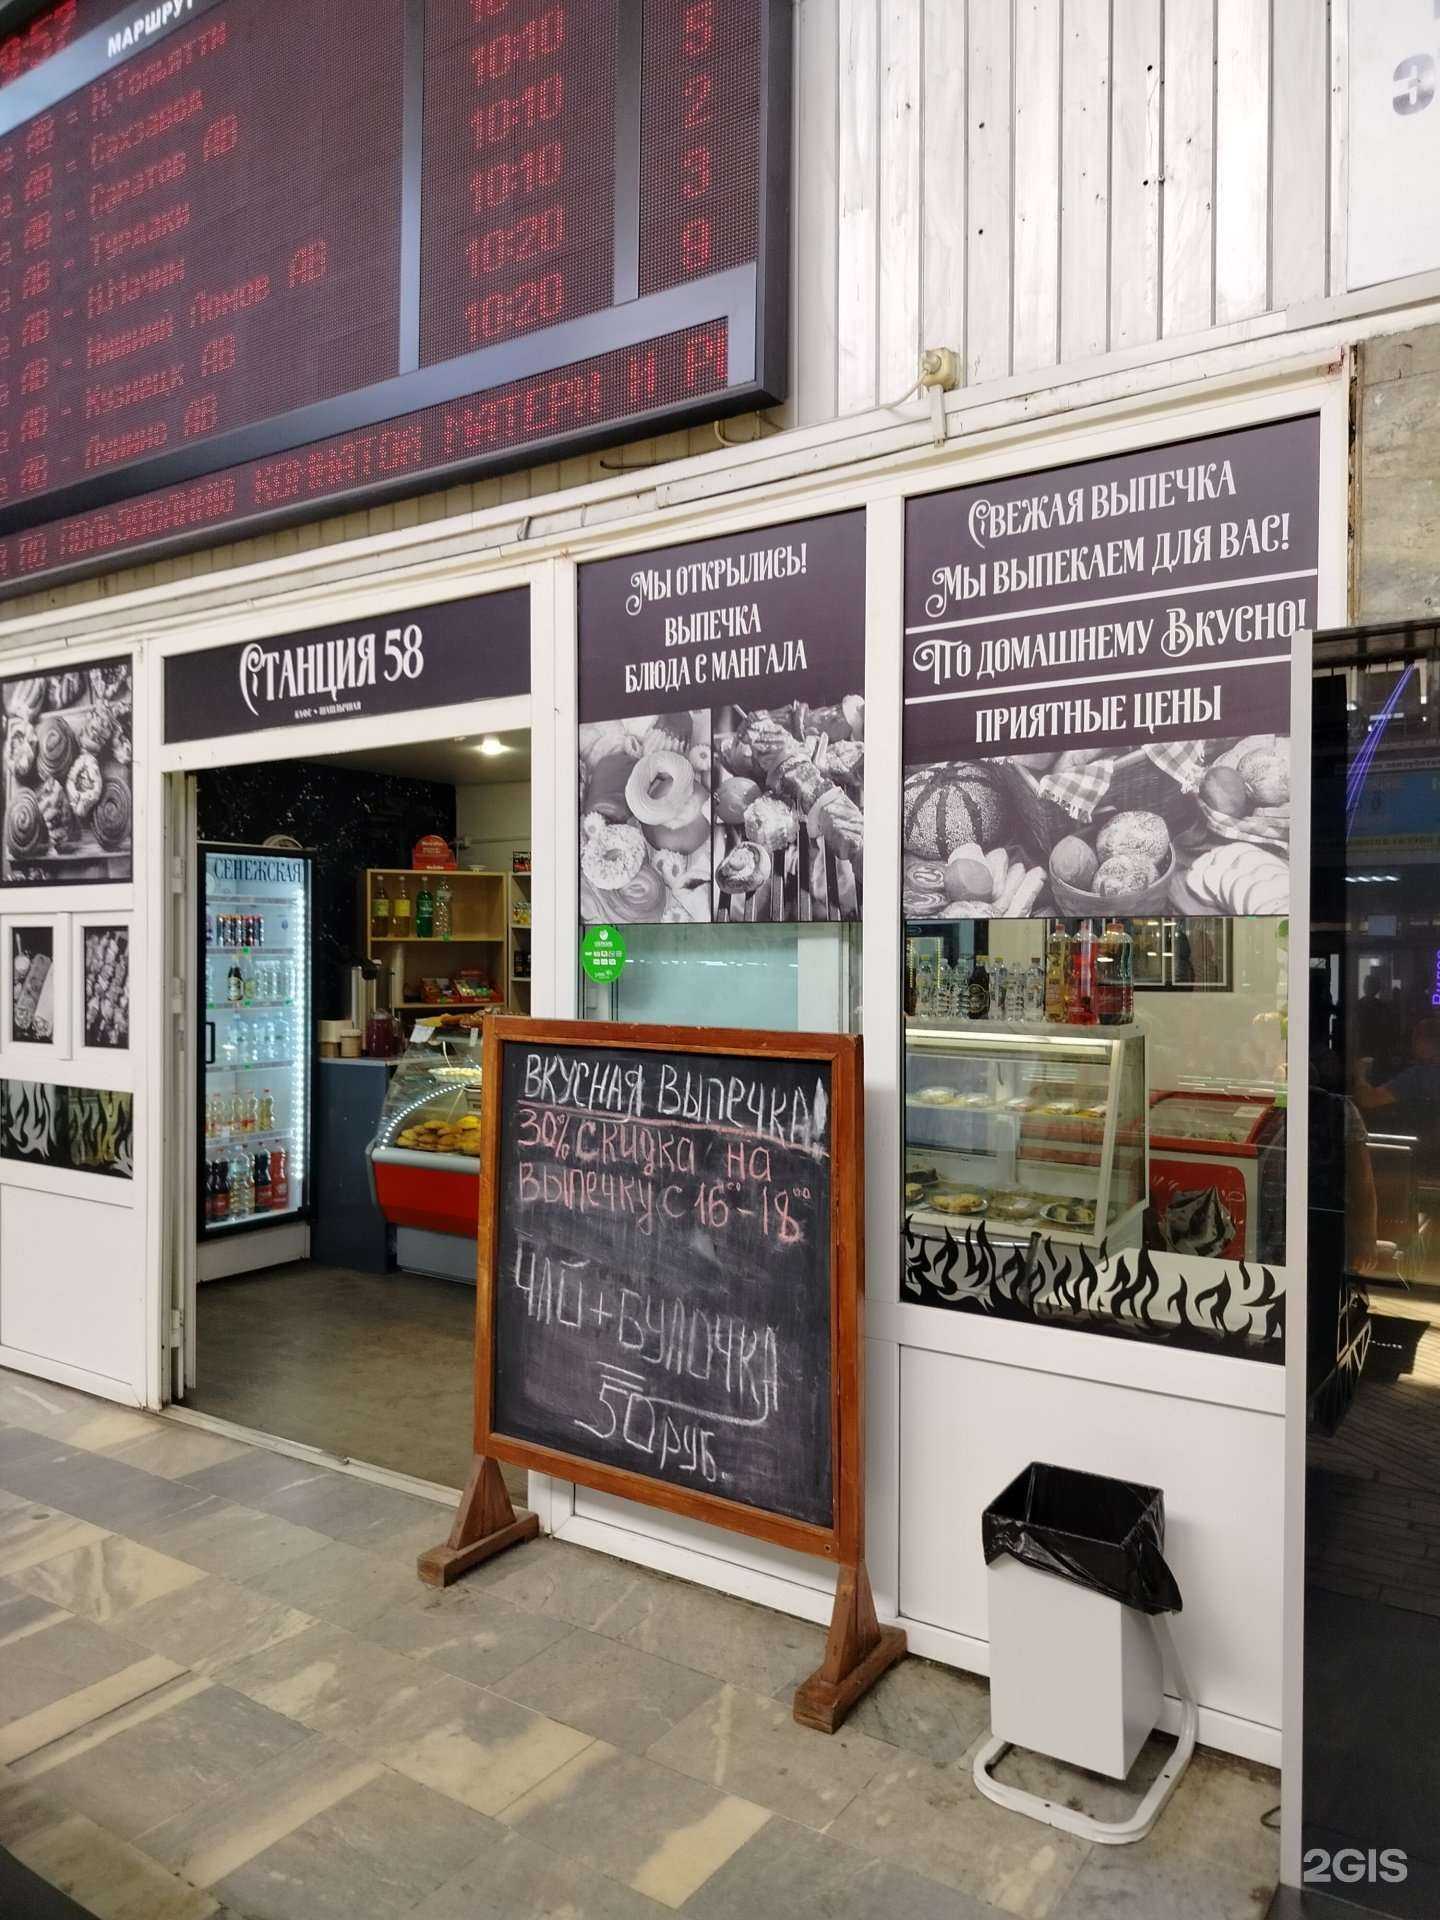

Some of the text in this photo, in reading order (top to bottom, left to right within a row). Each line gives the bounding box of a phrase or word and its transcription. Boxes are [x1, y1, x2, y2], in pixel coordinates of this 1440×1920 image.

[471, 5, 564, 86] 10:10
[470, 72, 563, 150] 10:10
[682, 73, 712, 129] 2
[470, 141, 562, 215] 10:10
[681, 147, 712, 200] 3
[287, 238, 329, 290] АВ
[465, 205, 565, 279] 10:20
[464, 271, 563, 344] 10:20
[201, 334, 236, 378] АВ
[183, 392, 218, 439] АВ
[444, 370, 600, 452] МАТЕРИ
[628, 351, 656, 404] И
[1091, 460, 1237, 521] ВЫПЕЧКА
[676, 542, 808, 596] ОТКРЫЛИСЬ!
[993, 536, 1145, 595] ВЫПЕКАЕМ
[1151, 527, 1214, 576] ДЛЯ
[1219, 512, 1291, 560] ВАС!
[384, 623, 425, 683] 58
[664, 602, 762, 648] ВЫПЕЧКА
[976, 617, 1155, 681] ДОМАШНЕМУ
[625, 639, 808, 694] БЛЮДА С МАНГАЛА
[975, 685, 1222, 744] ПРИЯТНЫЕ ЦЕНЫ
[214, 857, 302, 883] СЕНЕЖСКАЯ
[524, 1053, 644, 1119] ВКУСНАЯ
[518, 1107, 570, 1161] 30%
